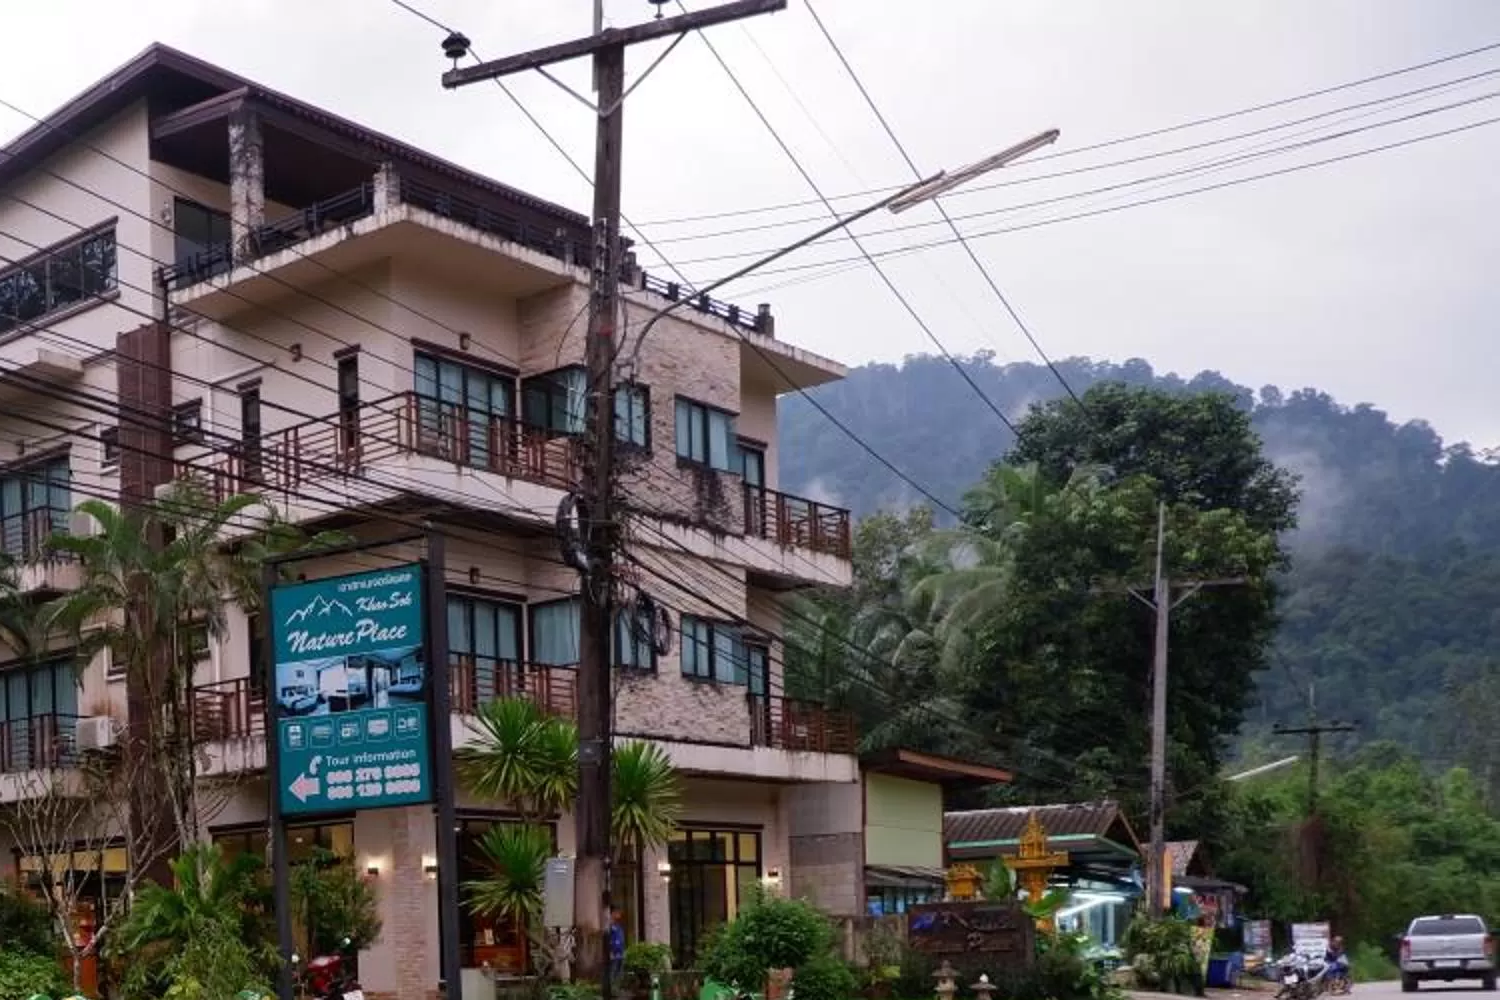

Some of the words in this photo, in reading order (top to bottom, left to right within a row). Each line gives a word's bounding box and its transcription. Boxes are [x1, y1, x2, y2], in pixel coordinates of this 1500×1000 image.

[287, 629, 355, 653] Nature
[355, 618, 407, 643] Place
[326, 755, 350, 767] Tour
